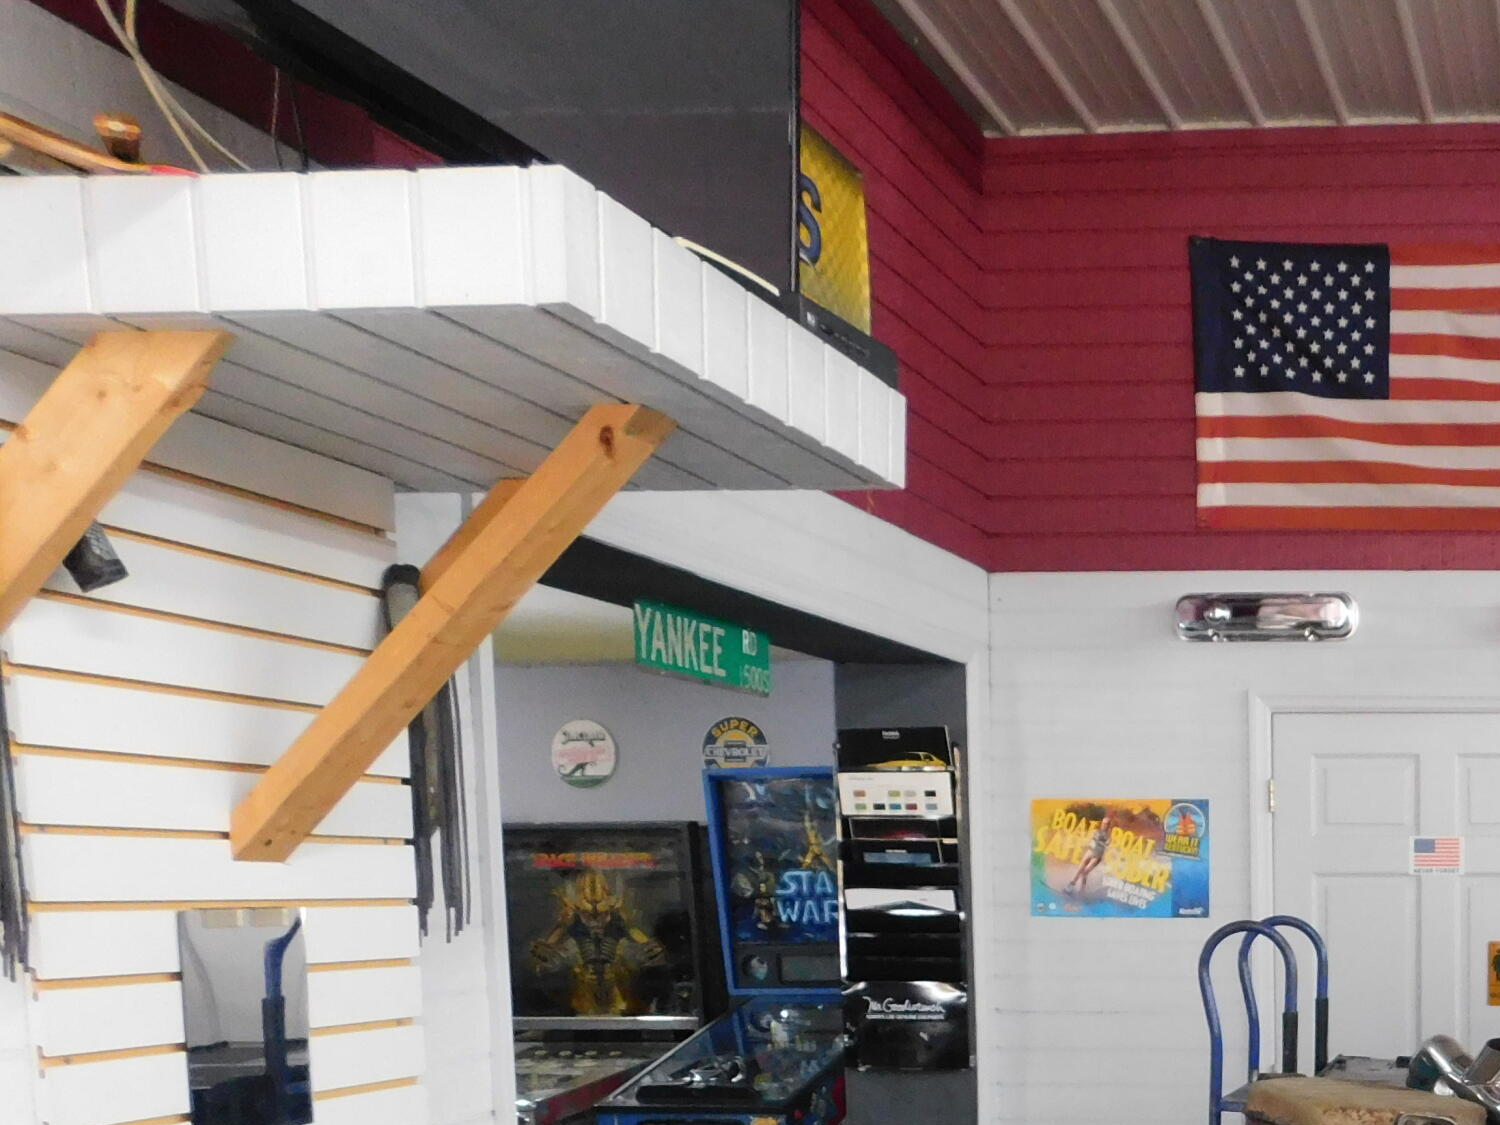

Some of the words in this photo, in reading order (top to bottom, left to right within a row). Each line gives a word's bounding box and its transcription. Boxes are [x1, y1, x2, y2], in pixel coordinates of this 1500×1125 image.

[634, 603, 727, 678] YANKEE
[742, 629, 758, 656] RD
[711, 719, 760, 738] SUPER
[1110, 826, 1156, 857] BOAT
